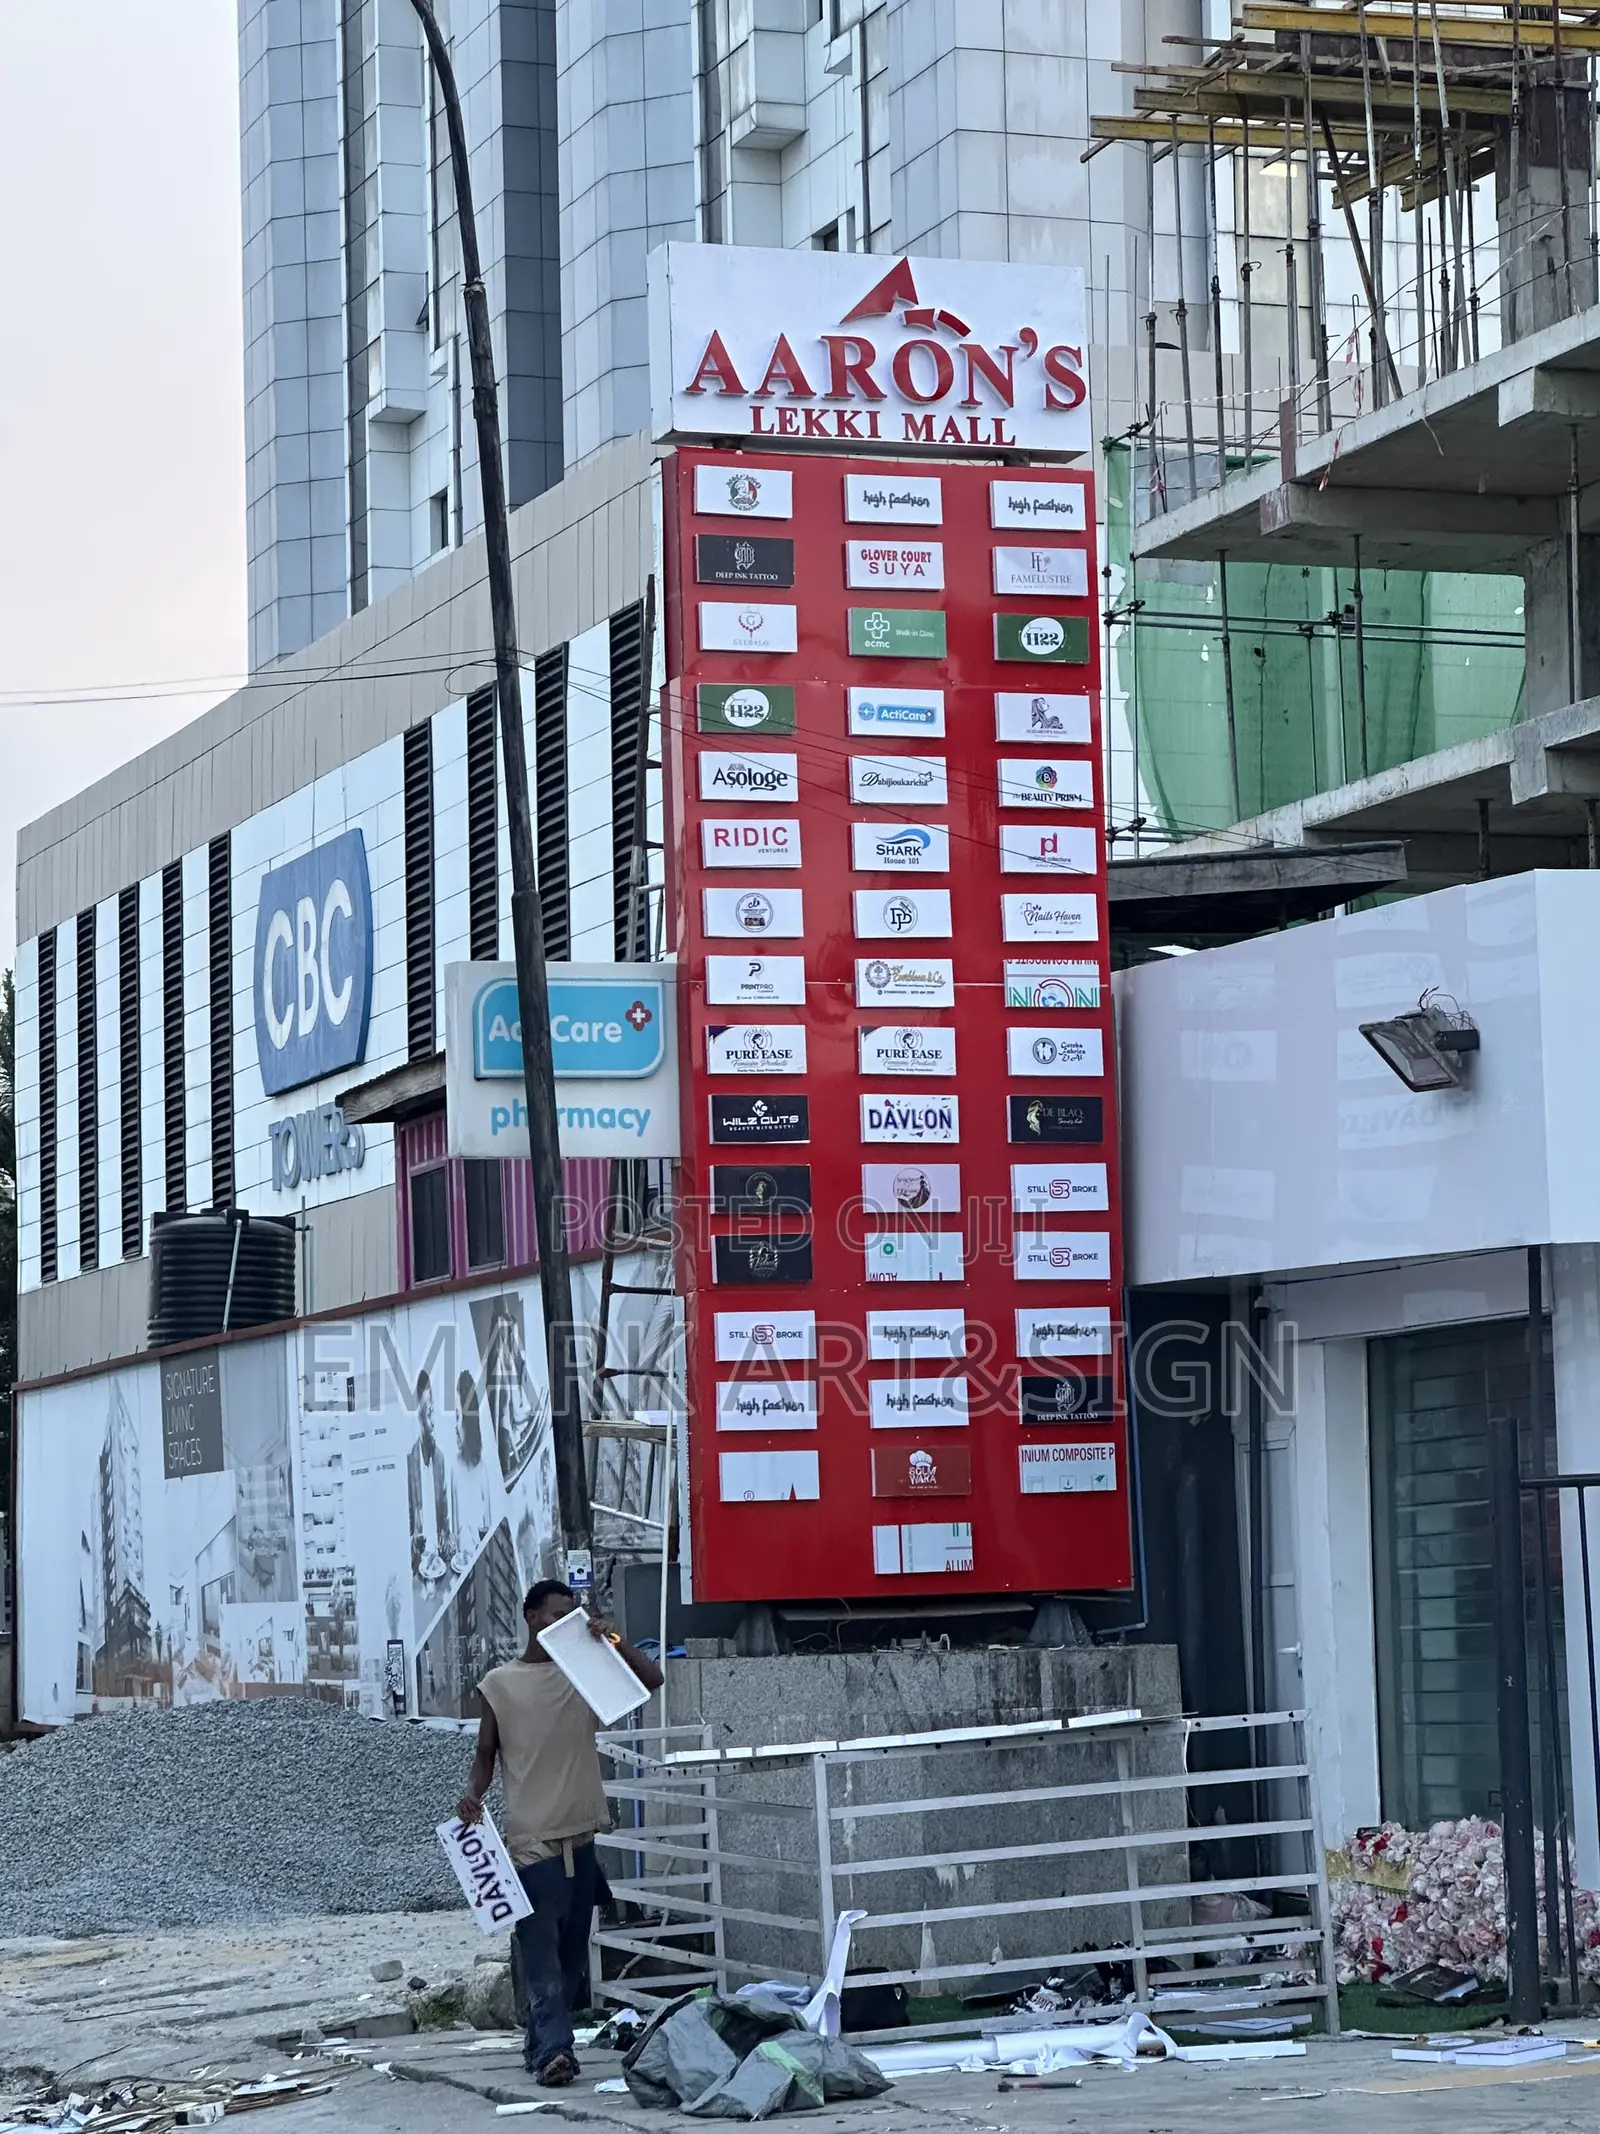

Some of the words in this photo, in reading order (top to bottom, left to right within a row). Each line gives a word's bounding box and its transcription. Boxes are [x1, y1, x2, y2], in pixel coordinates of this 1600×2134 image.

[683, 327, 1088, 411] AARON'S
[748, 405, 882, 439] LEKKI
[901, 412, 1016, 447] MALL
[863, 490, 886, 508] high
[888, 491, 930, 509] fashion
[1008, 496, 1030, 514] high
[1033, 497, 1073, 515] fashion
[860, 549, 898, 562] GLOVER
[900, 550, 932, 563] COURT
[715, 571, 734, 580] DEEP
[734, 572, 749, 580] INK
[749, 572, 778, 581] TATTOO
[869, 562, 925, 577] SUYA
[1011, 574, 1072, 584] FAMELUSTRE
[895, 629, 919, 637] Walk-in
[864, 640, 890, 648] ecmc
[880, 709, 927, 721] ActiCare
[1020, 793, 1054, 802] BEAUTY
[1054, 793, 1083, 803] PRISM
[713, 826, 788, 847] RIDIC
[876, 844, 922, 856] SHARK
[884, 857, 907, 865] House
[908, 857, 920, 865] 101
[1028, 910, 1053, 922] Nails
[1053, 910, 1081, 922] Haven
[263, 878, 353, 1051] CBC
[488, 1015, 622, 1043] AcCare
[726, 1050, 759, 1060] PURE
[761, 1049, 793, 1059] EASE
[876, 1049, 911, 1059] PURE
[911, 1049, 943, 1060] EASE
[490, 1098, 652, 1138] phrmacy
[722, 1117, 758, 1127] WILZ
[760, 1115, 799, 1125] CUTS
[868, 1109, 953, 1130] DAVLON
[1027, 1185, 1047, 1194] STILL
[1071, 1185, 1098, 1193] BROKE
[1072, 1253, 1098, 1261] BROKE
[729, 1331, 751, 1339] STILL
[776, 1331, 803, 1339] BROKE
[884, 1326, 907, 1343] high
[908, 1327, 951, 1344] fashion
[1032, 1323, 1054, 1340] high
[1056, 1323, 1098, 1341] fashion
[165, 1365, 215, 1400] SIGNATURE
[736, 1398, 760, 1416] high
[762, 1398, 804, 1416] fashion
[886, 1393, 910, 1412] high
[912, 1393, 955, 1411] fashion
[1070, 1412, 1098, 1420] TATTOO
[168, 1437, 202, 1470] SPACES
[1052, 1447, 1107, 1462] COMPOSITE
